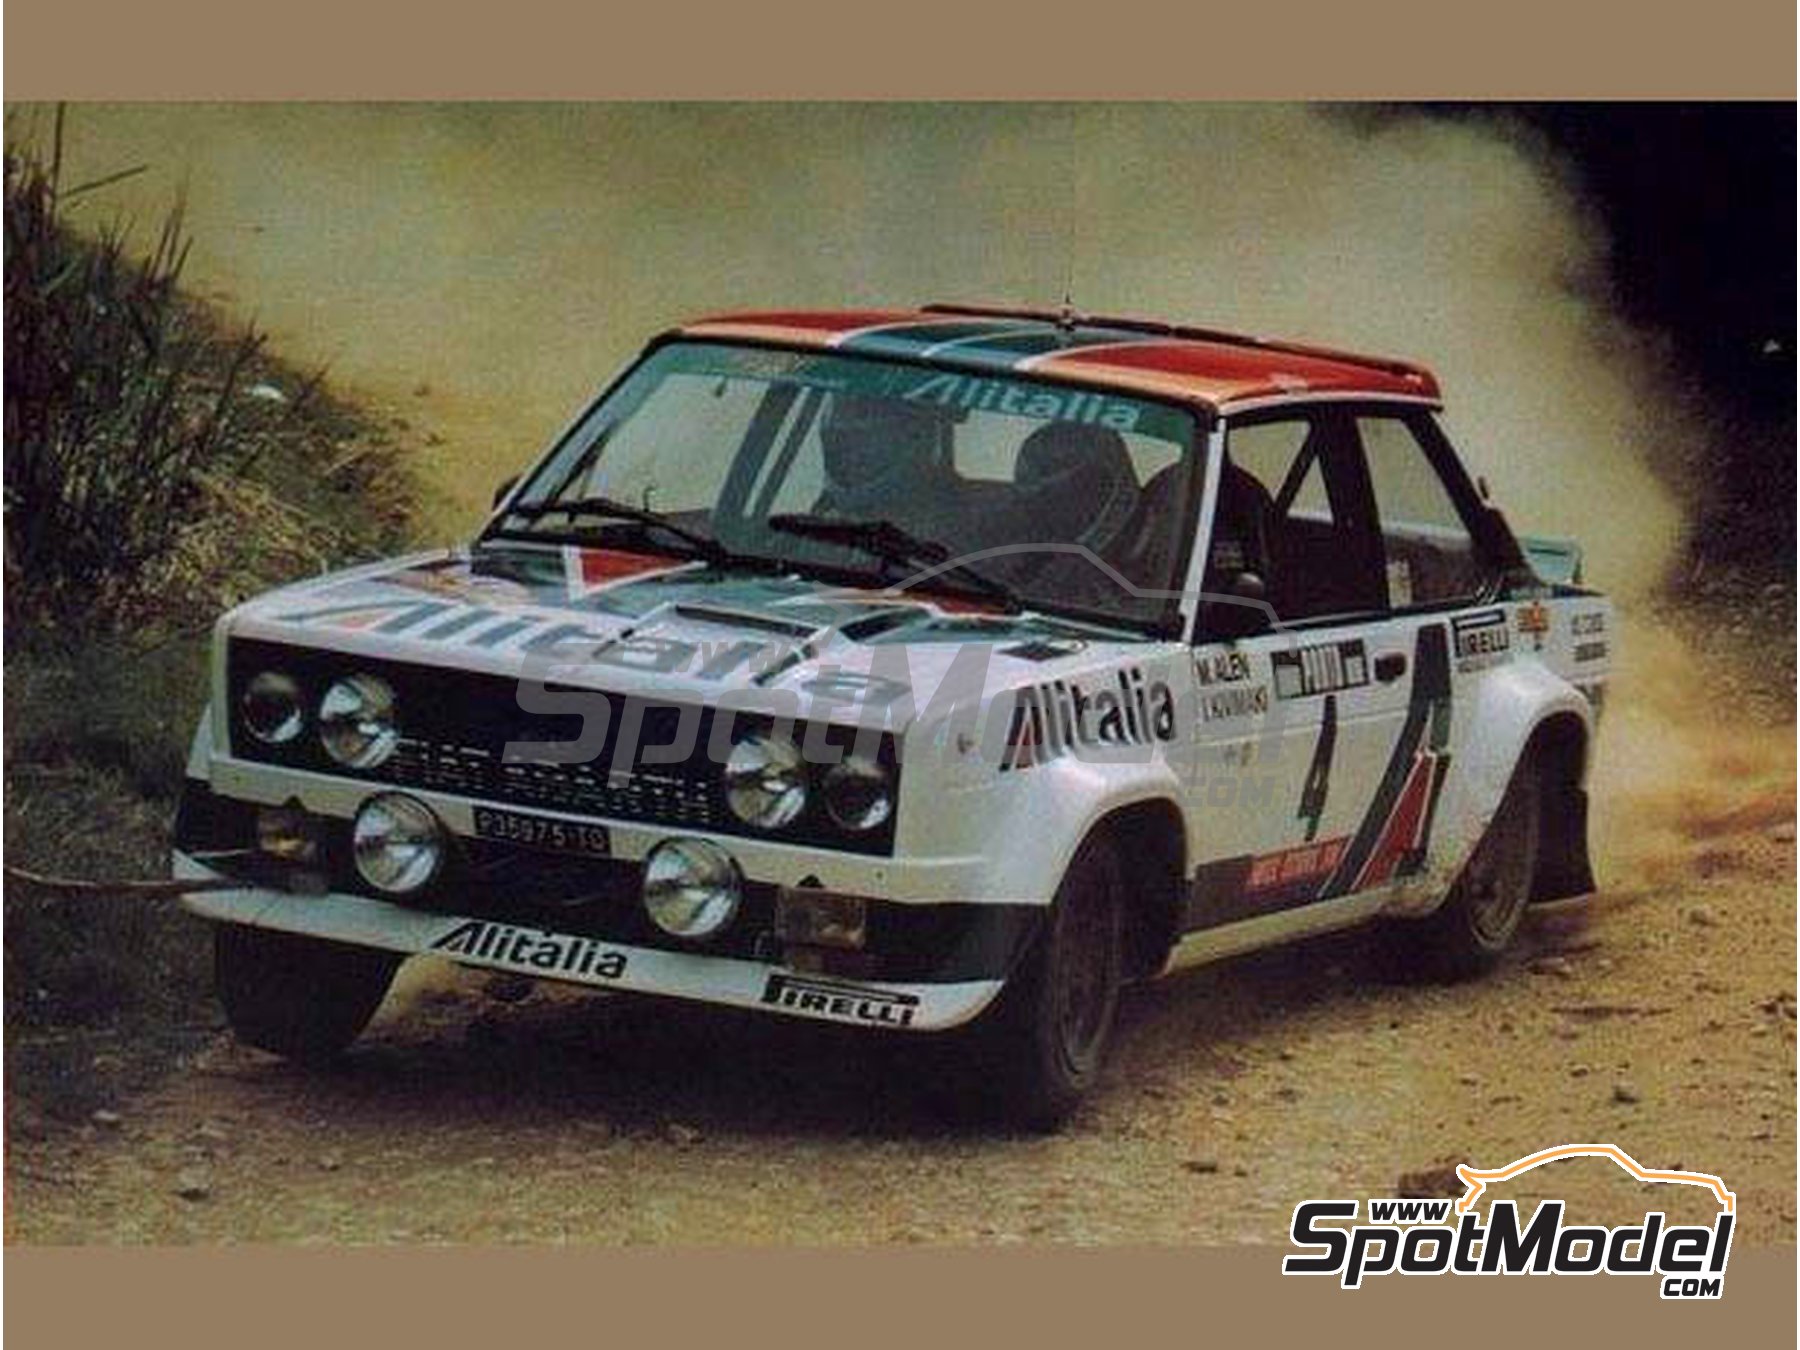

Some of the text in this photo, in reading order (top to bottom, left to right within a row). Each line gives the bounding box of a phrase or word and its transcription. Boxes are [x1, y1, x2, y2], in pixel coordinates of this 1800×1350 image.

[903, 372, 1142, 434] Alitalia
[998, 666, 1178, 772] Alitalia
[1298, 694, 1338, 842] 4
[431, 920, 629, 980] Alitalia
[761, 974, 921, 1027] PIRELLI
